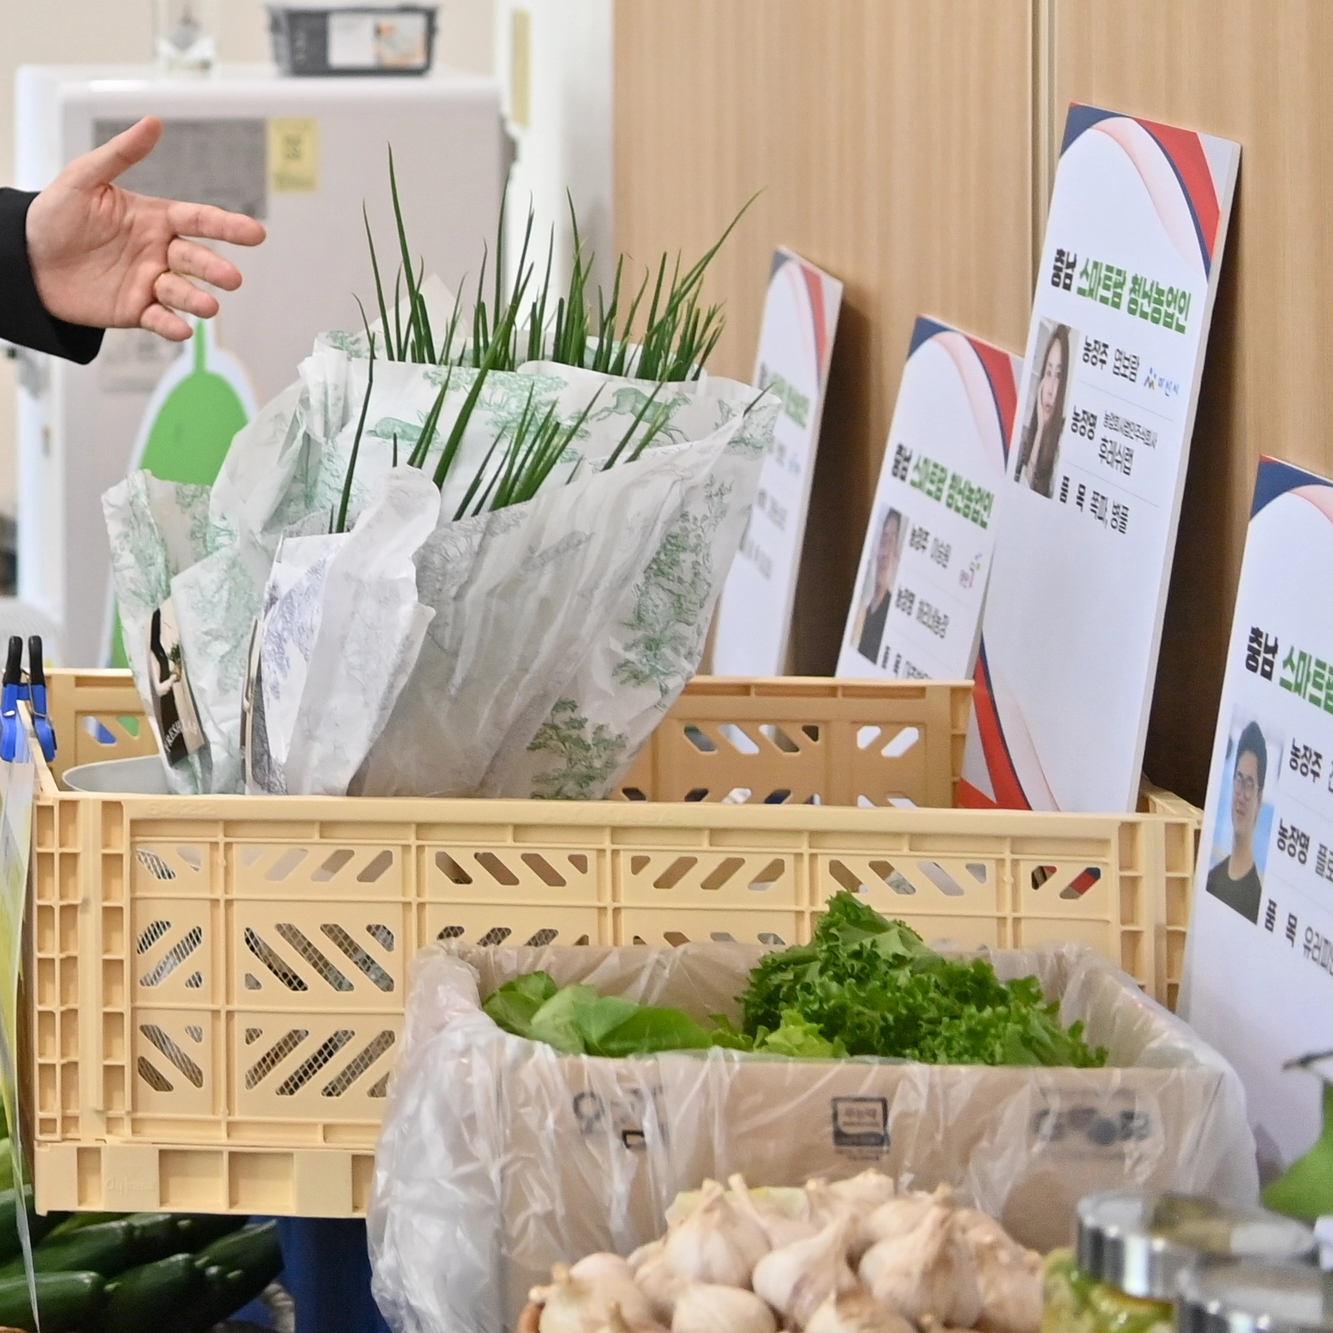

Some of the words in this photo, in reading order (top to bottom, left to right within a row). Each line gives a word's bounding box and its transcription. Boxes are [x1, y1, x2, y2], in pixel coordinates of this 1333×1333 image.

[1051, 248, 1077, 291] 충남
[1077, 258, 1127, 310] 스마트팜
[1127, 273, 1191, 334] 청년농업인
[1083, 335, 1109, 370] 농장주
[1113, 348, 1140, 383] 염보람
[1071, 405, 1098, 440] 농장명
[1098, 435, 1134, 476] 후레쉬랩
[891, 442, 913, 482] 충남
[909, 453, 948, 502] 스마트팜
[945, 471, 994, 530] 청년농업인
[1059, 475, 1070, 504] 품
[1076, 483, 1086, 512] 목
[909, 523, 930, 555] 농장주
[895, 584, 916, 616] 농장명
[1245, 626, 1279, 682] 충남
[1289, 737, 1322, 783] 농장주
[1276, 817, 1310, 865] 농장명
[1264, 898, 1277, 933] 품
[1285, 912, 1298, 948] 목
